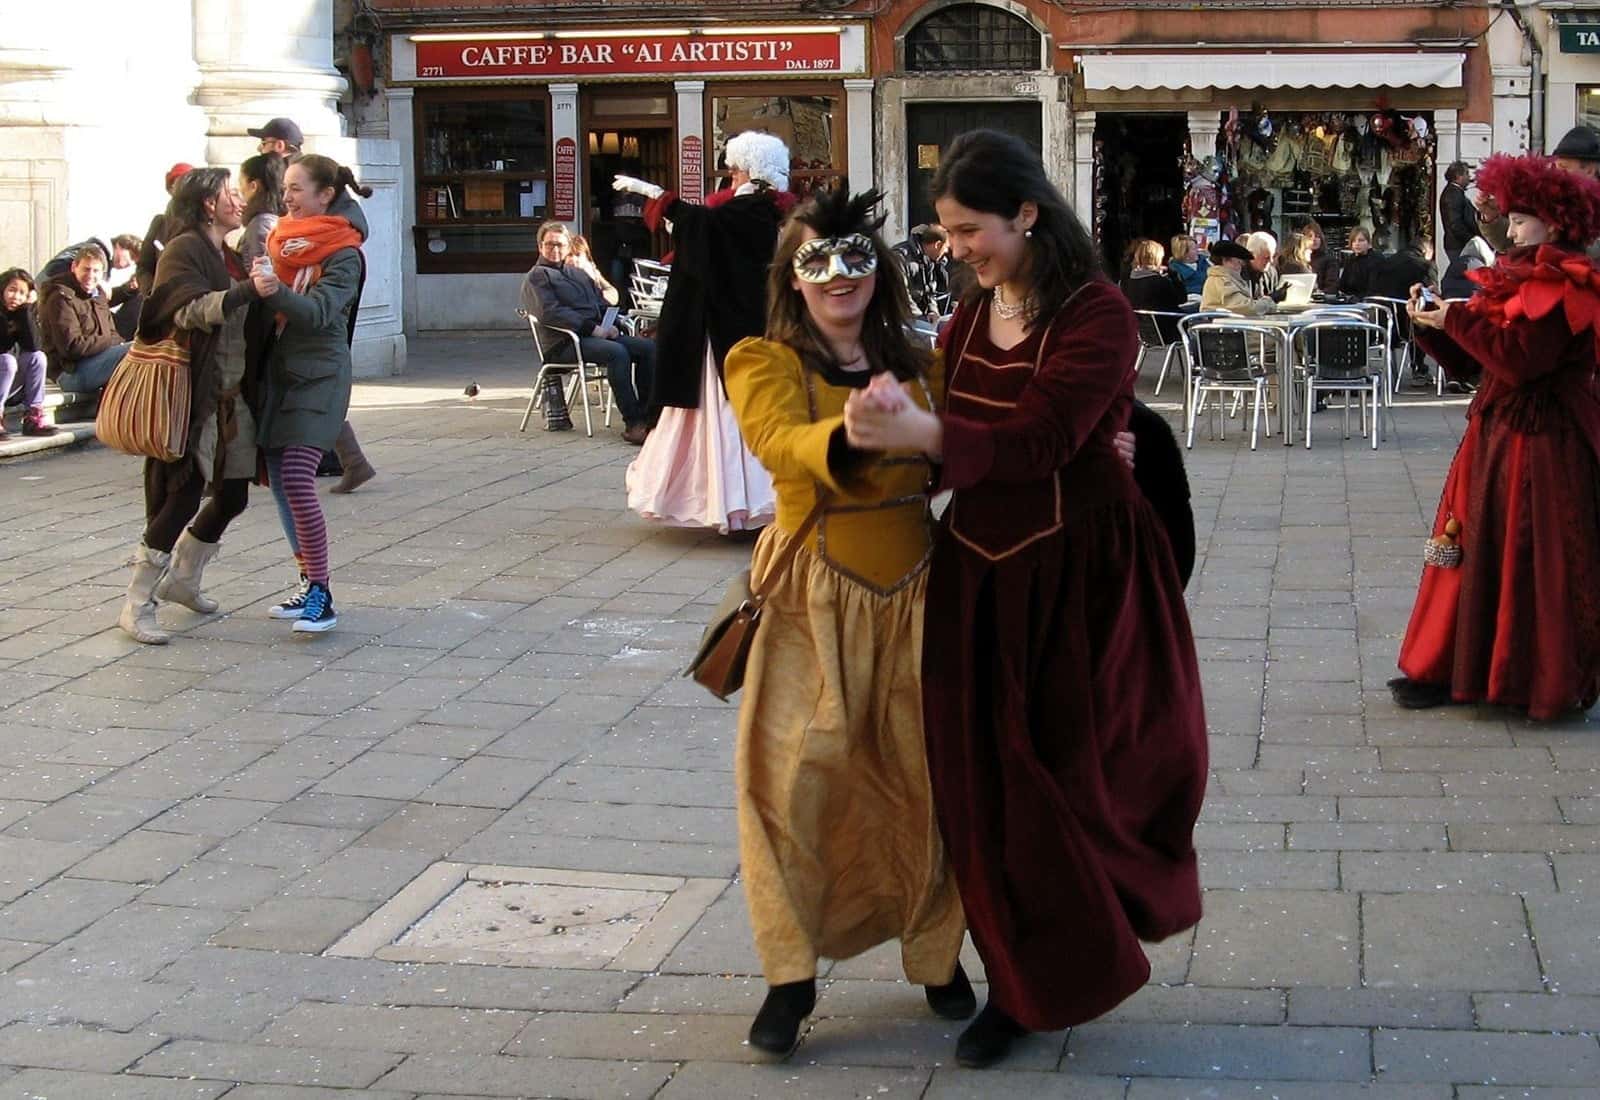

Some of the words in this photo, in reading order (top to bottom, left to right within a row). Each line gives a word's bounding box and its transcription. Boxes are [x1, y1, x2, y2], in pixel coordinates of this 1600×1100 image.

[1576, 31, 1600, 46] TA
[560, 44, 614, 64] BAR
[786, 60, 810, 70] DAL
[813, 59, 834, 69] 1897
[422, 66, 444, 77] 2771
